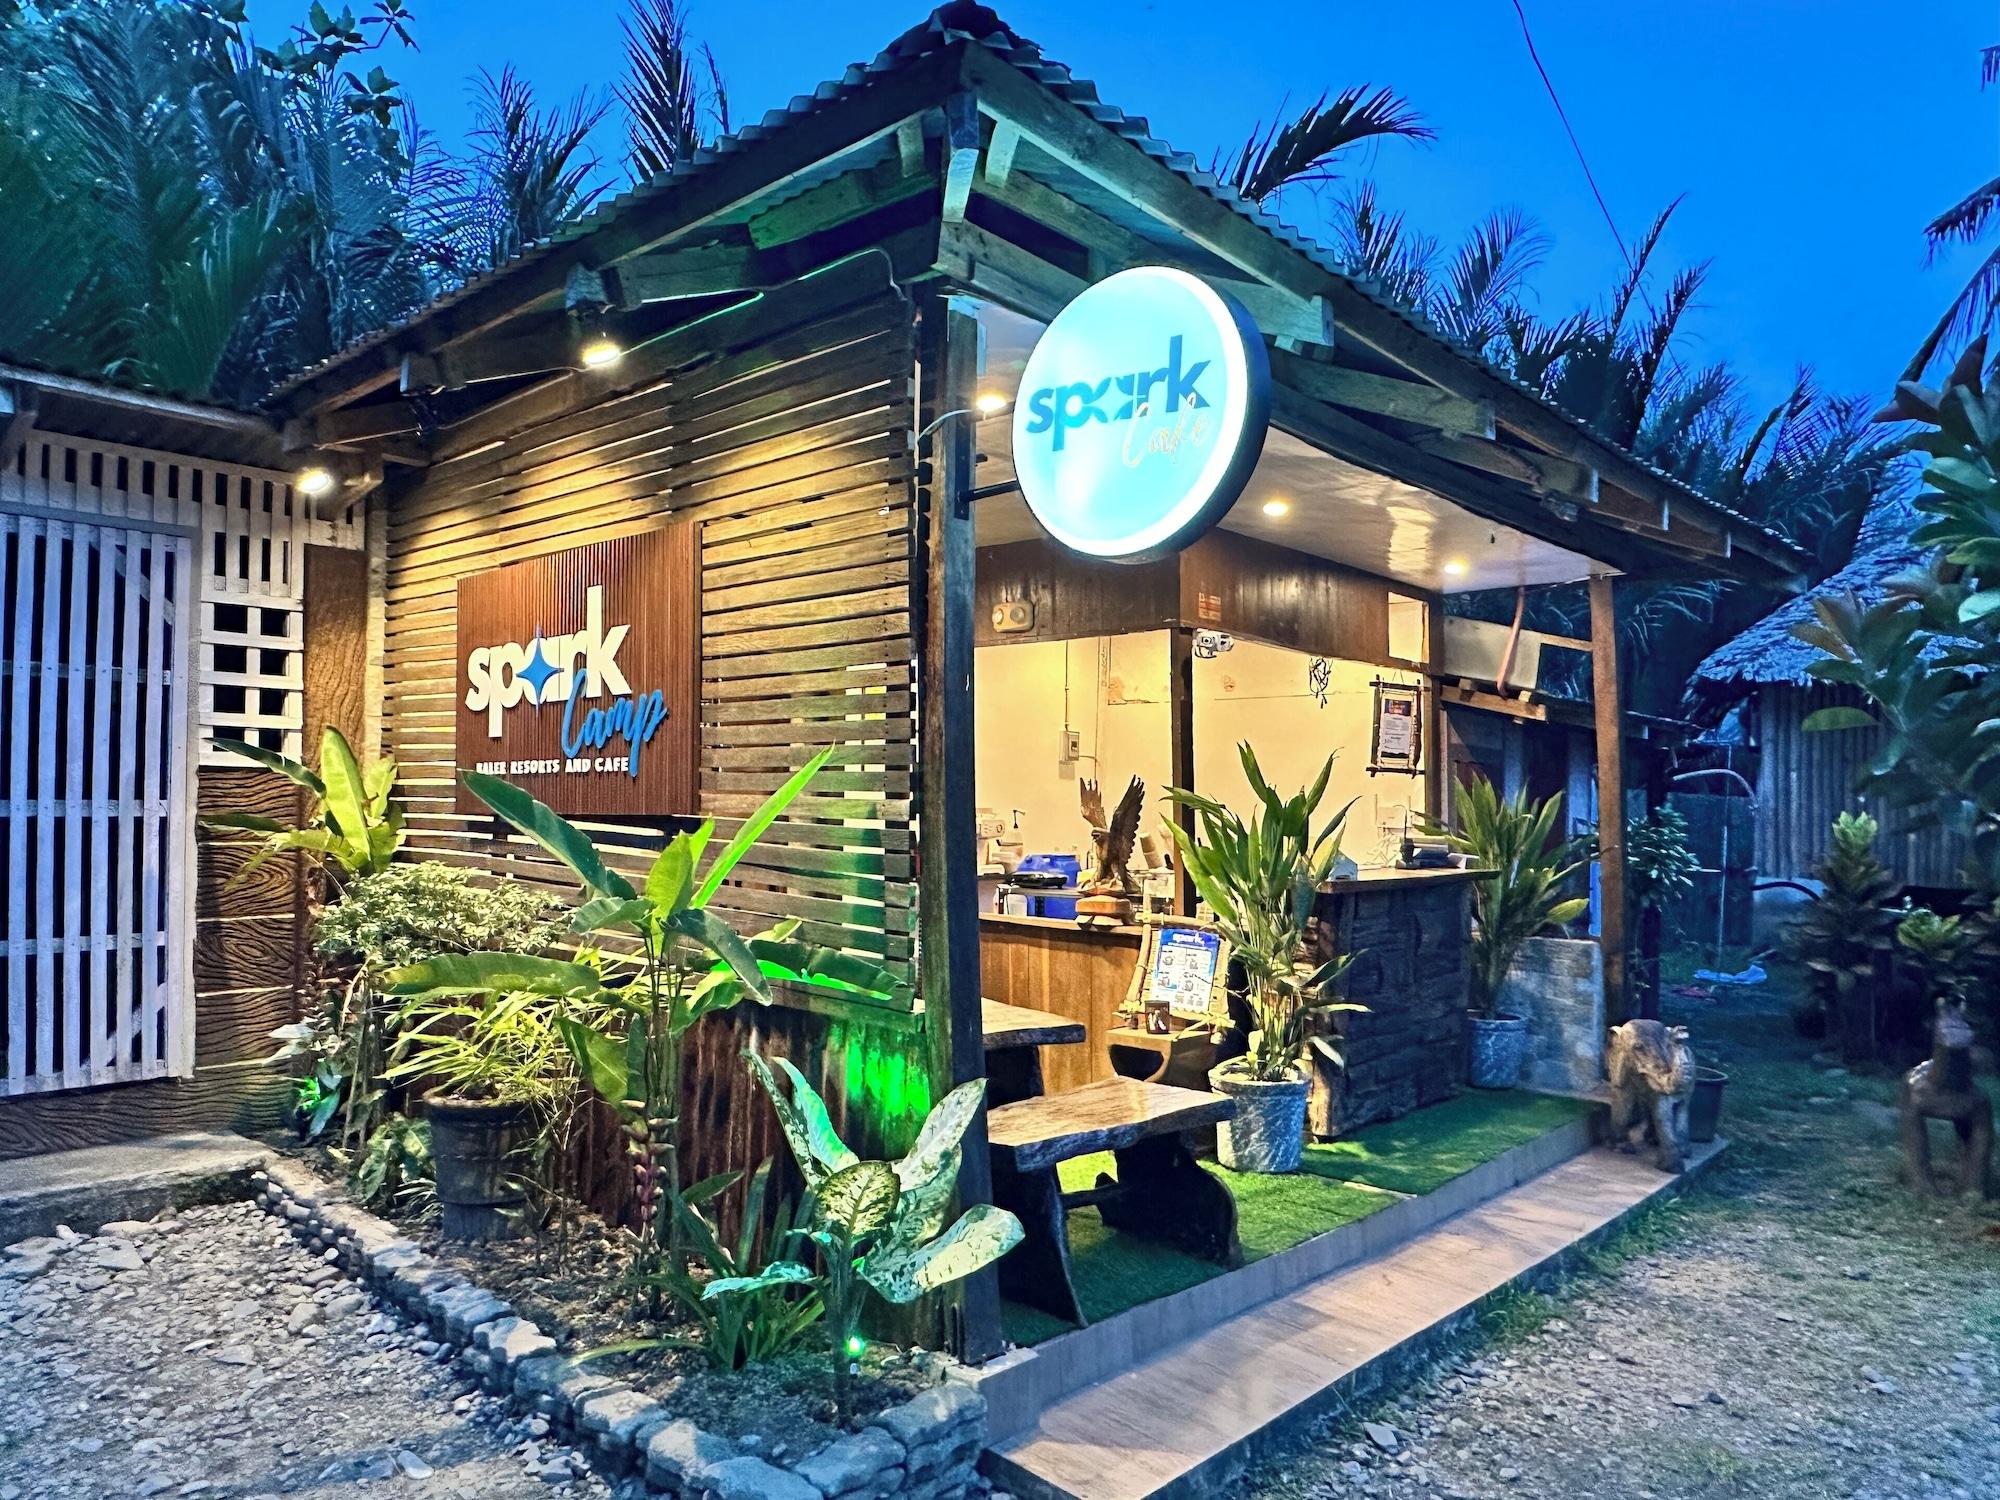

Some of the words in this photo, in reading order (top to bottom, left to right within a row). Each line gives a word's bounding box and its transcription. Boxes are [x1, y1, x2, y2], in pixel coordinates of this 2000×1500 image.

[1025, 334, 1211, 451] spark
[465, 584, 632, 738] spark
[510, 759, 560, 775] RESORTS
[565, 758, 591, 773] AND
[595, 756, 629, 772] CAFE
[562, 668, 667, 777] Camp
